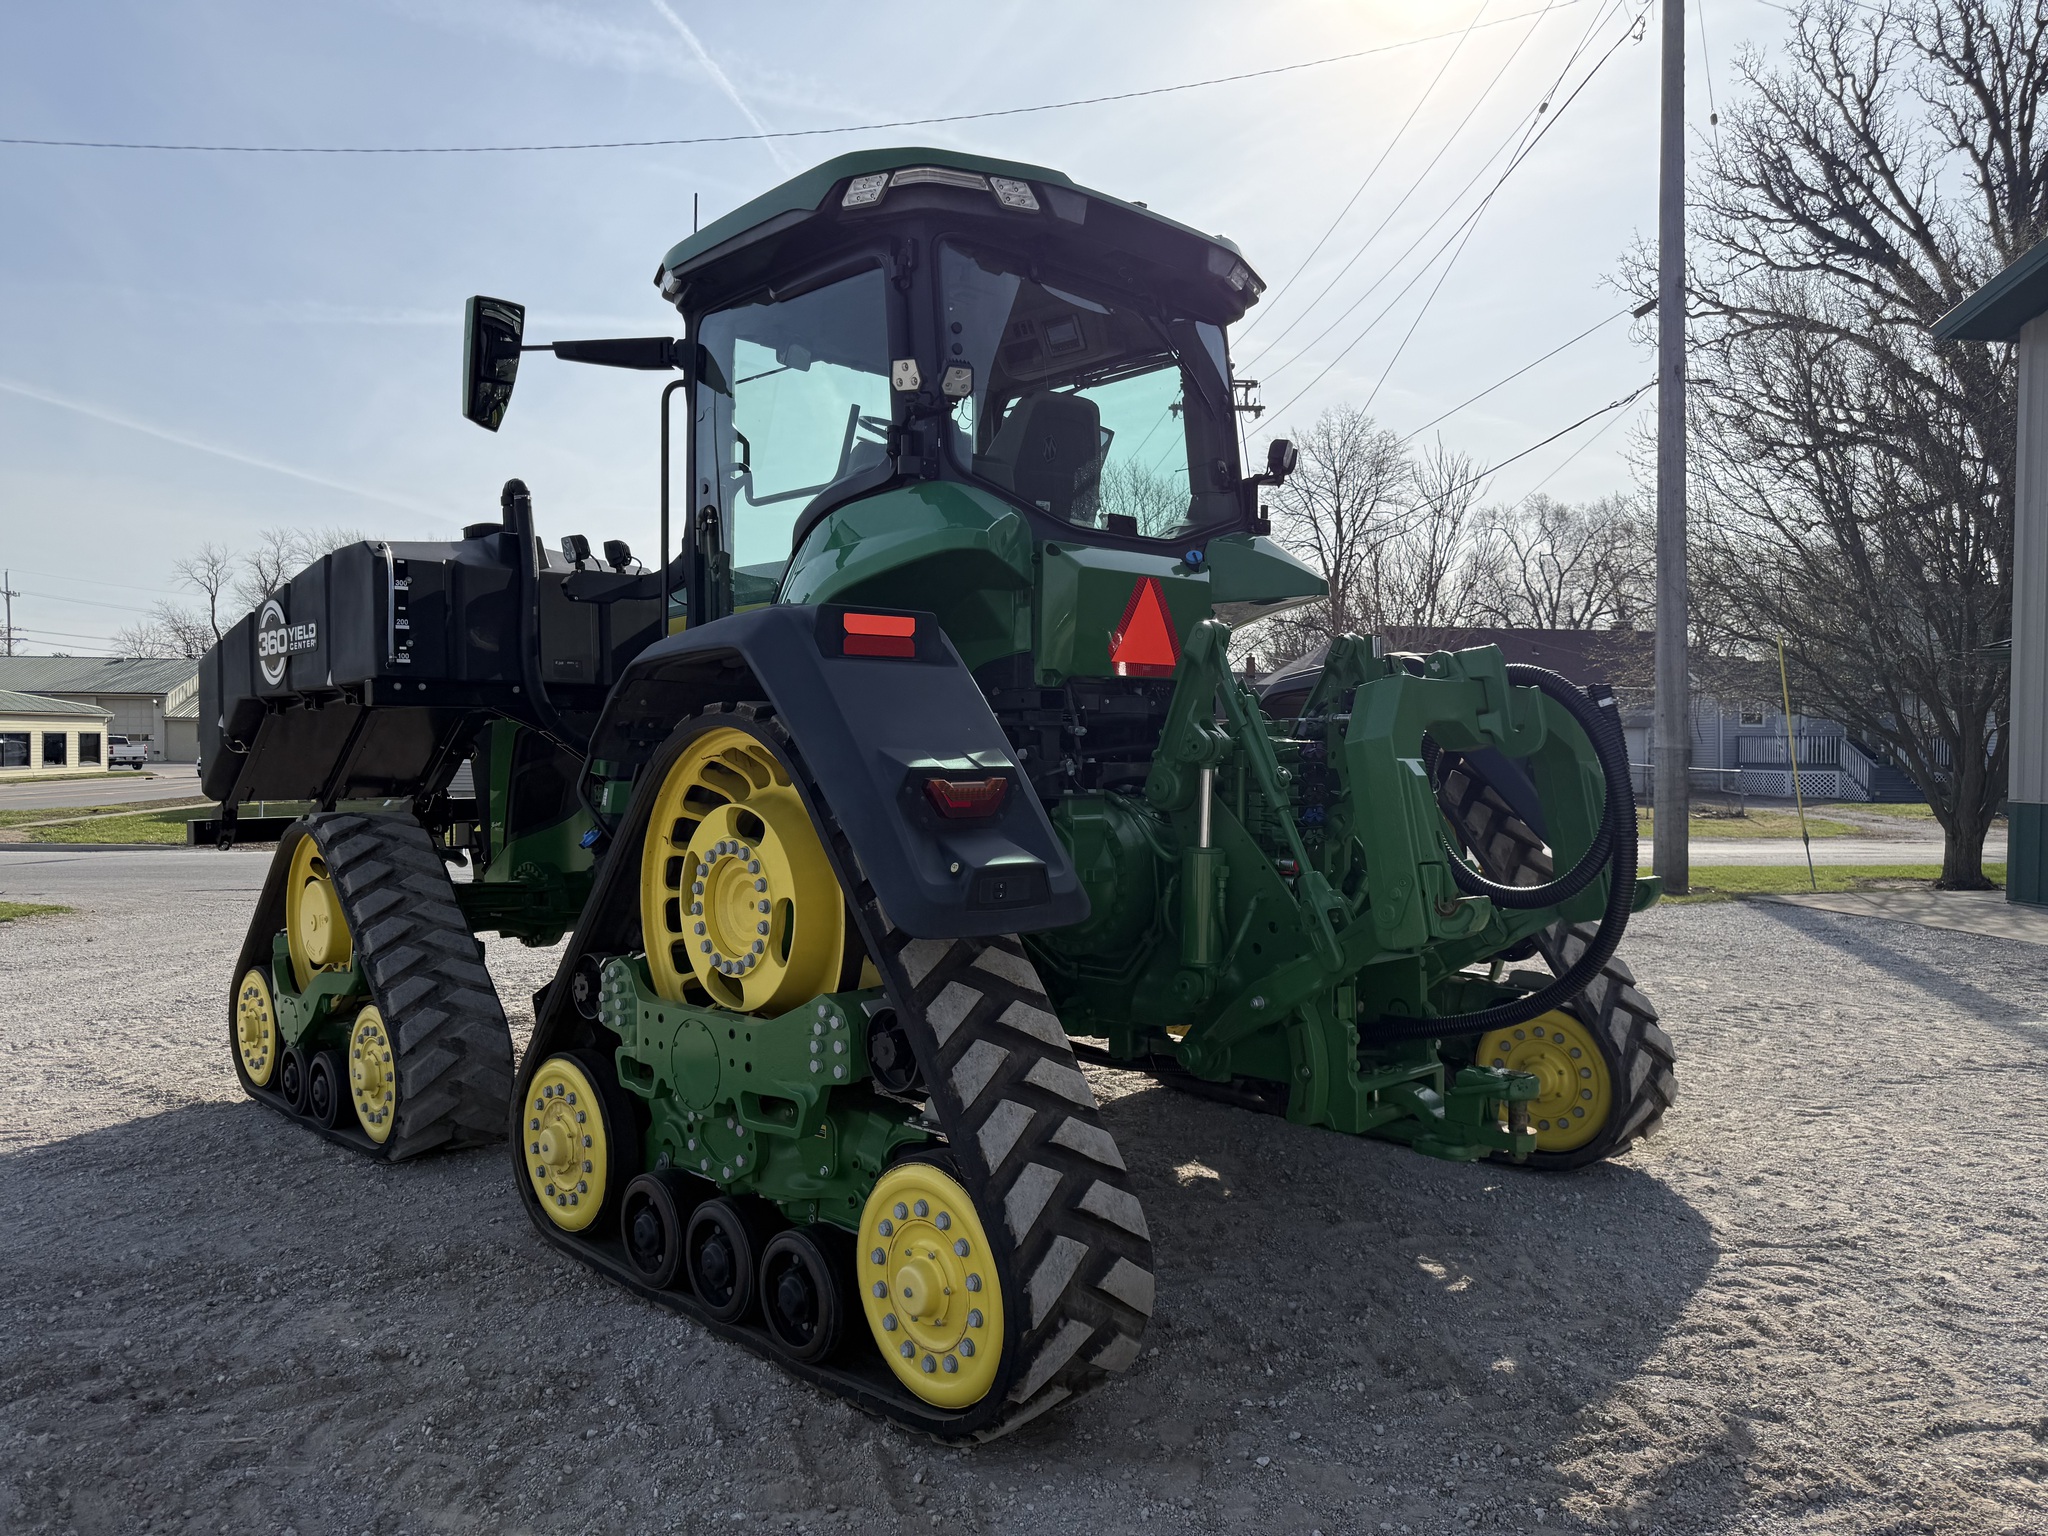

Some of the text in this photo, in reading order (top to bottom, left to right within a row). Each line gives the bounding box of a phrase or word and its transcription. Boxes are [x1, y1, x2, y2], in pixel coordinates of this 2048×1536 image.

[396, 618, 409, 626] 200
[258, 623, 316, 657] 360 YIELD
[289, 639, 315, 651] CENTER
